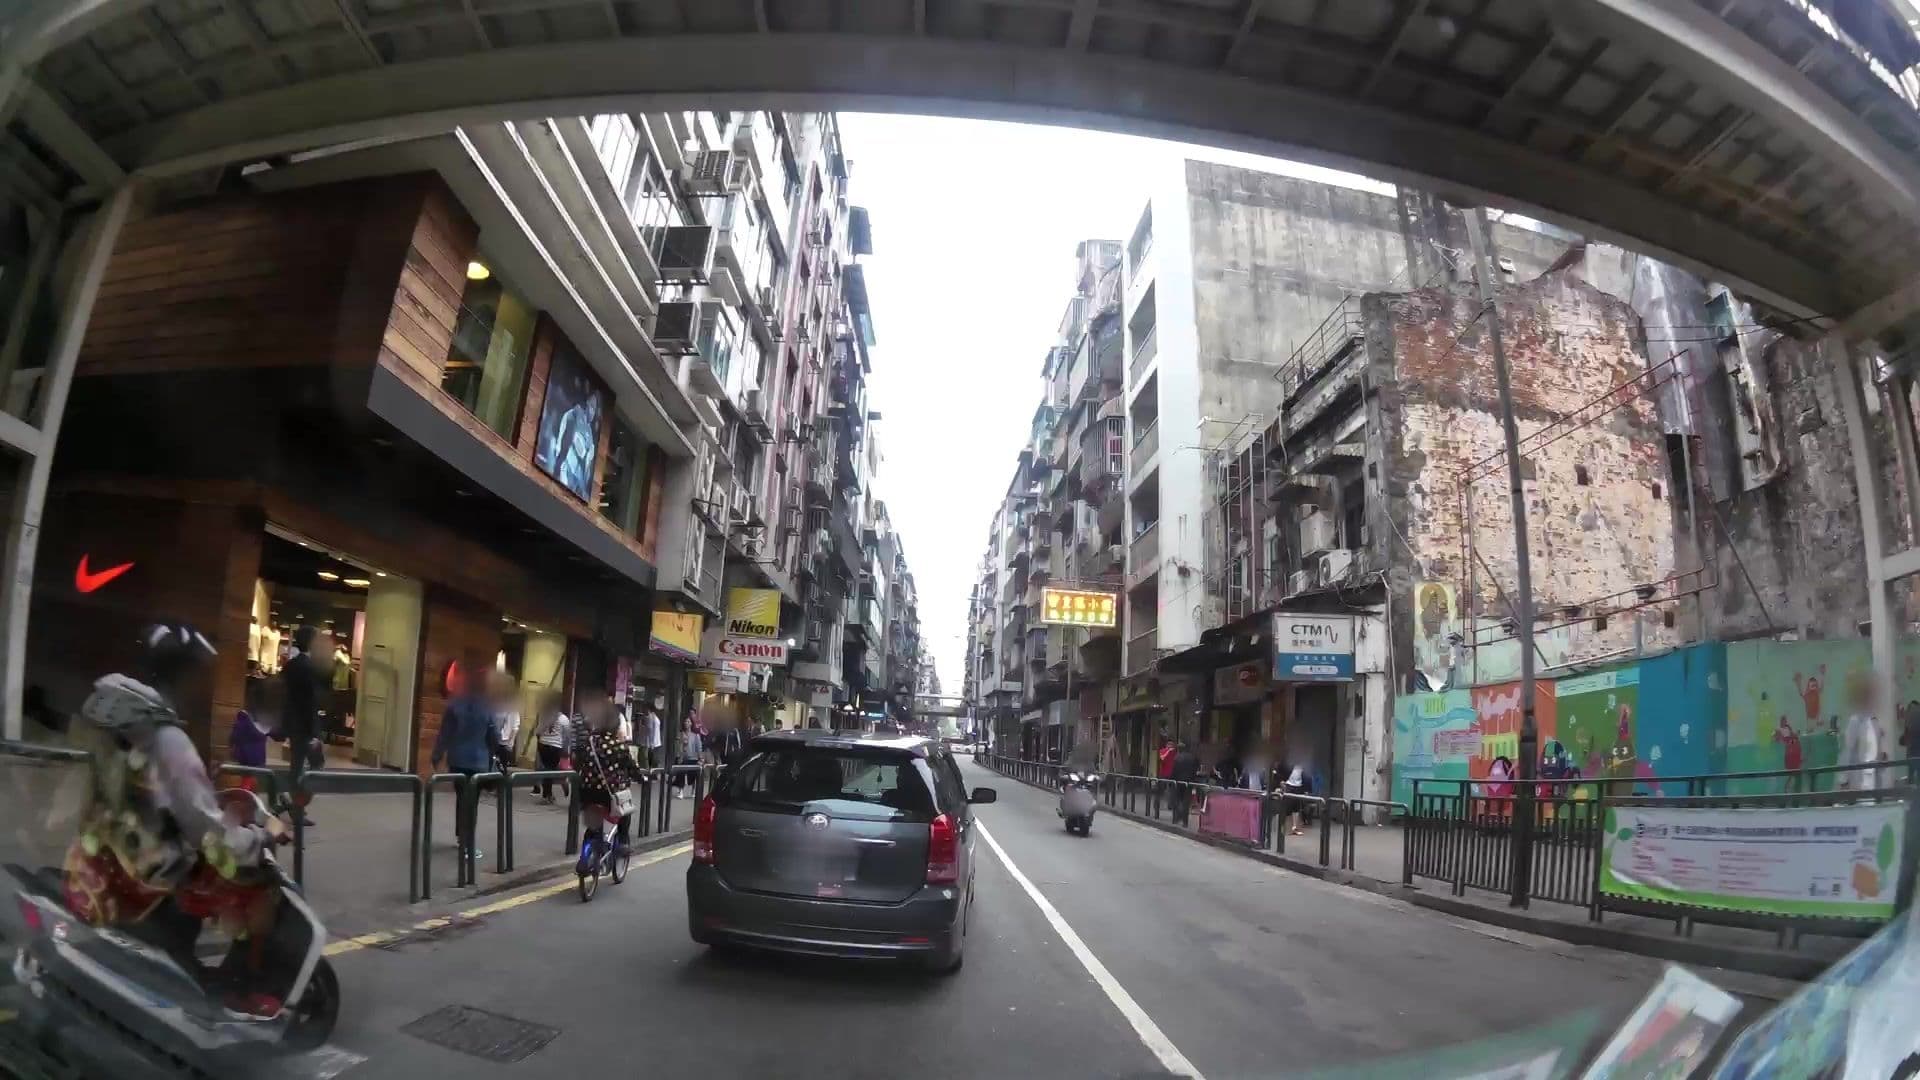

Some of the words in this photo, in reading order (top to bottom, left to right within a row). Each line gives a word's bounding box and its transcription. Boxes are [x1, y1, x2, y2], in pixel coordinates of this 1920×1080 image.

[730, 619, 775, 635] Nikon
[1291, 624, 1322, 636] CTM
[719, 639, 782, 658] Canon
